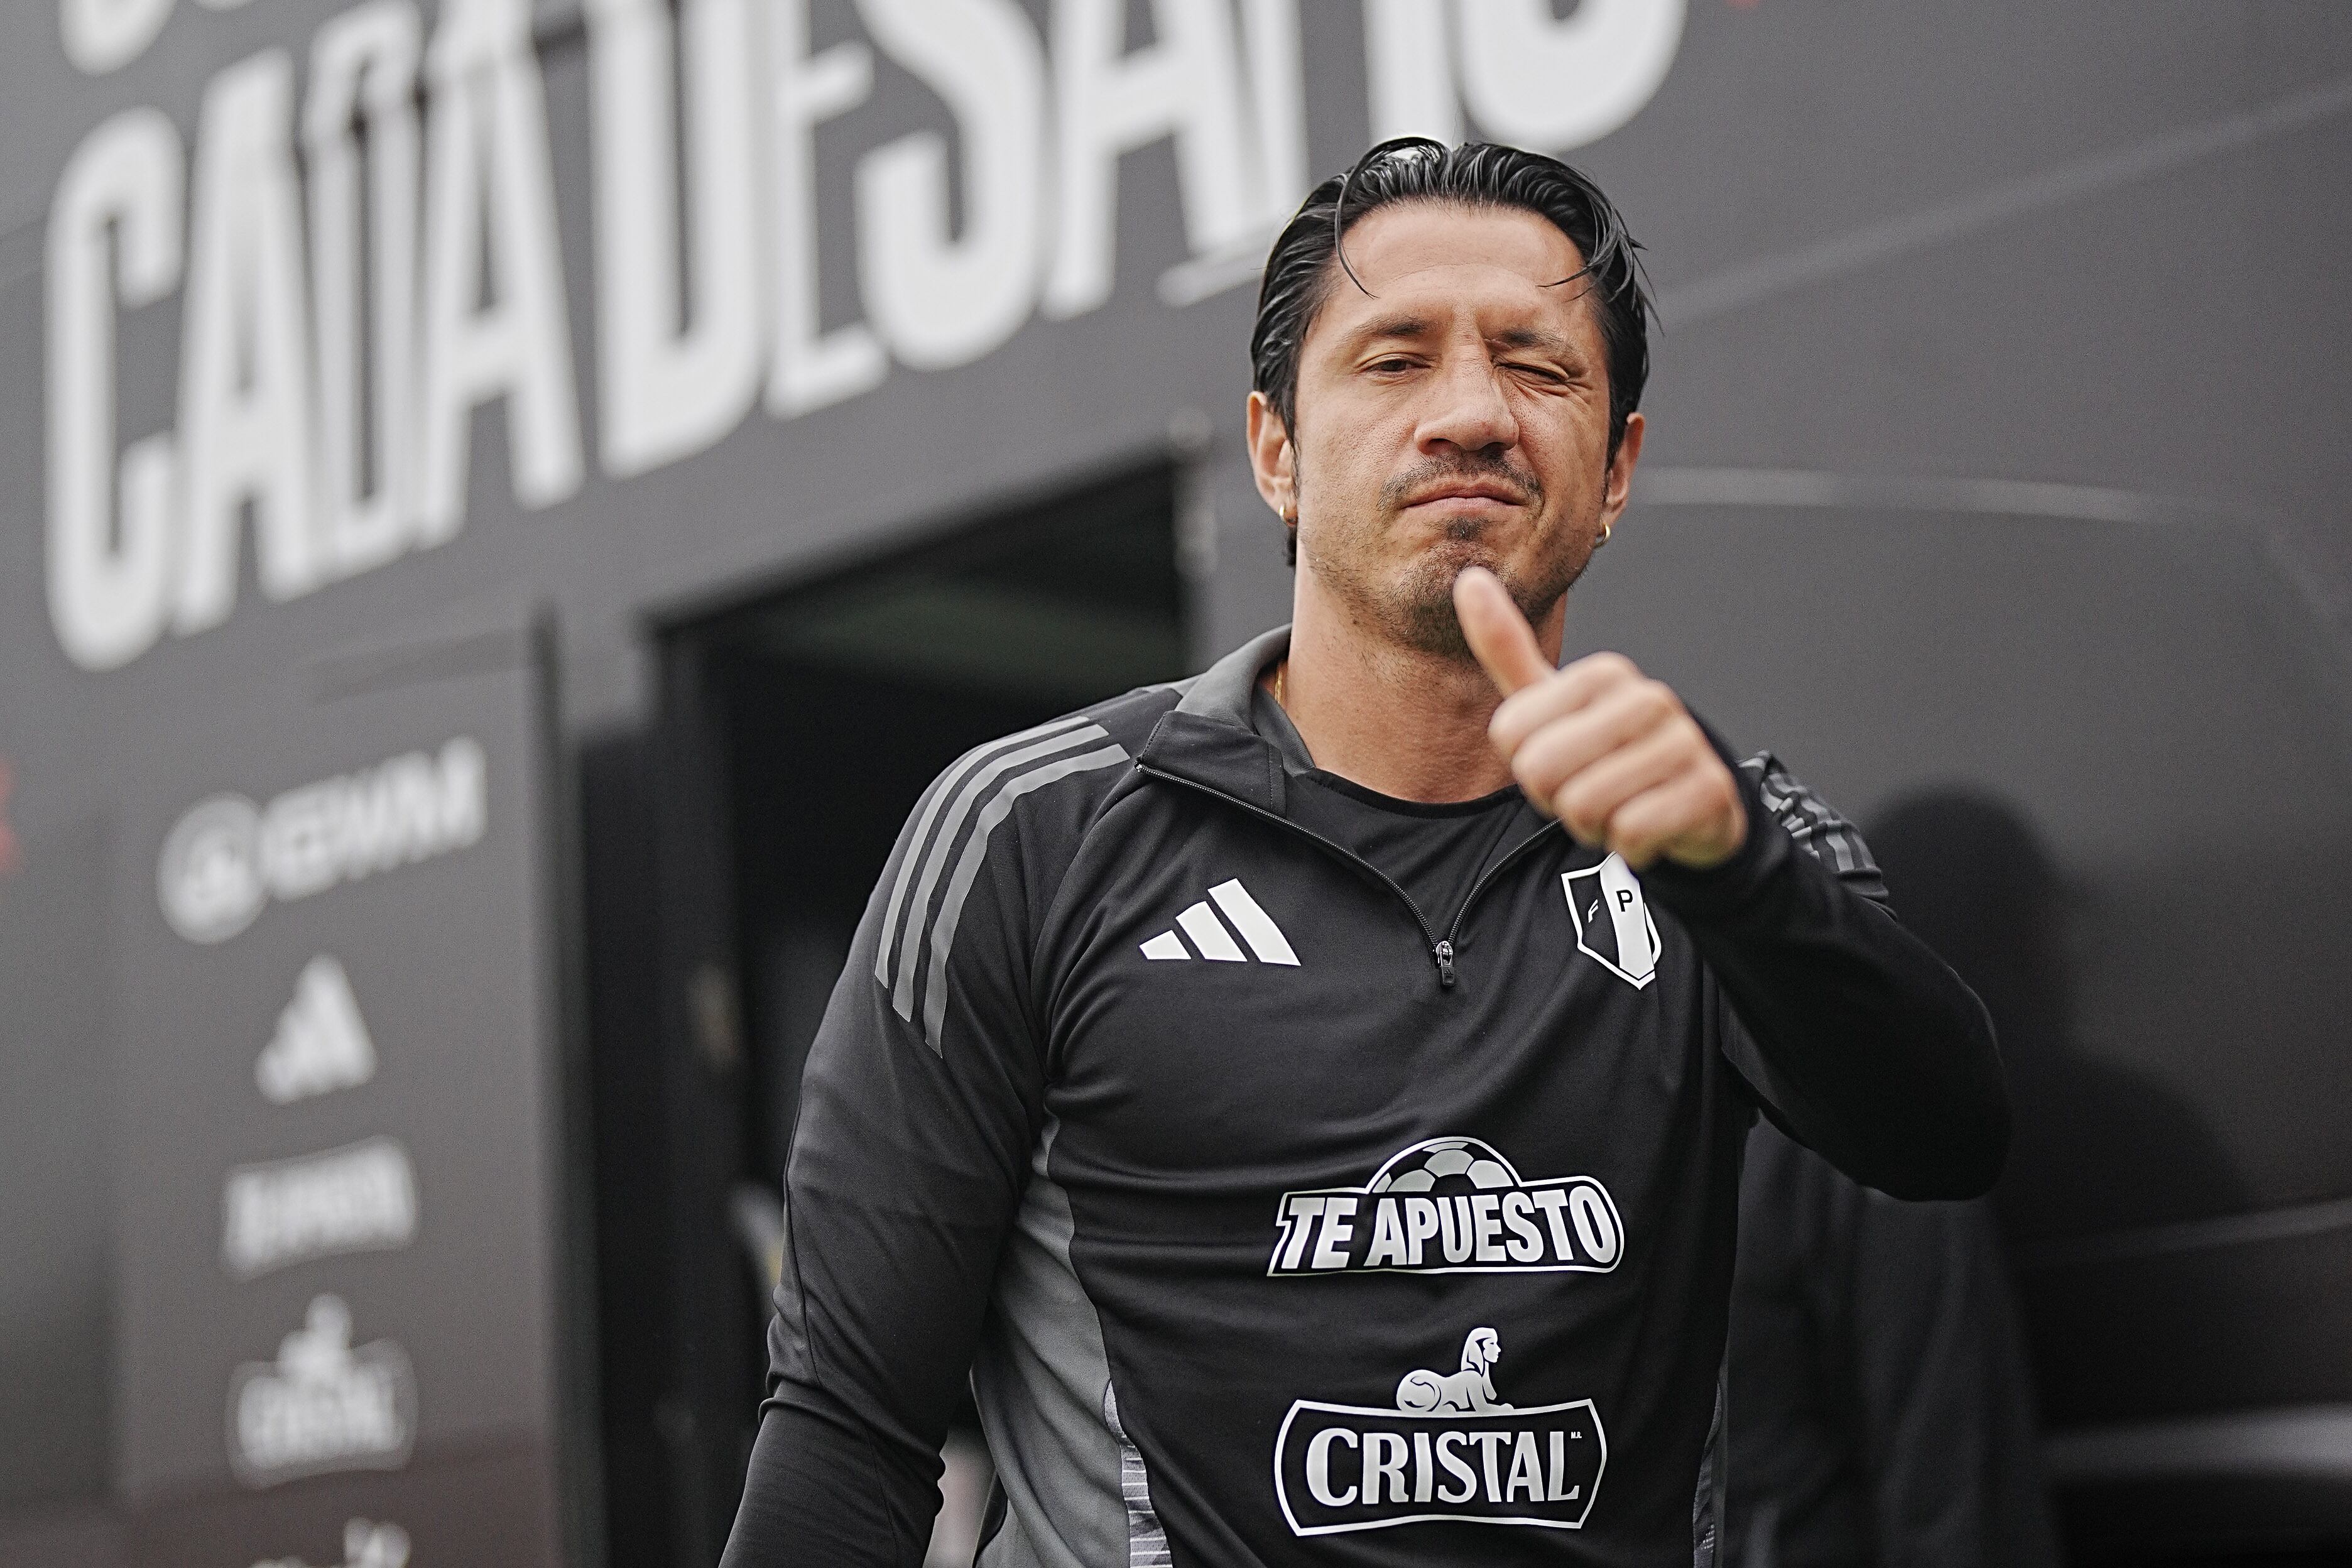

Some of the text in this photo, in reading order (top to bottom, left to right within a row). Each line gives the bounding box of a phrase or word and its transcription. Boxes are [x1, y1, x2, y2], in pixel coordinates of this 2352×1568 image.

[43, 0, 585, 671] CADA
[1616, 889, 1633, 912] P
[1280, 1185, 1617, 1270] TE APUESTO
[1306, 1428, 1579, 1506] CRISTAL
